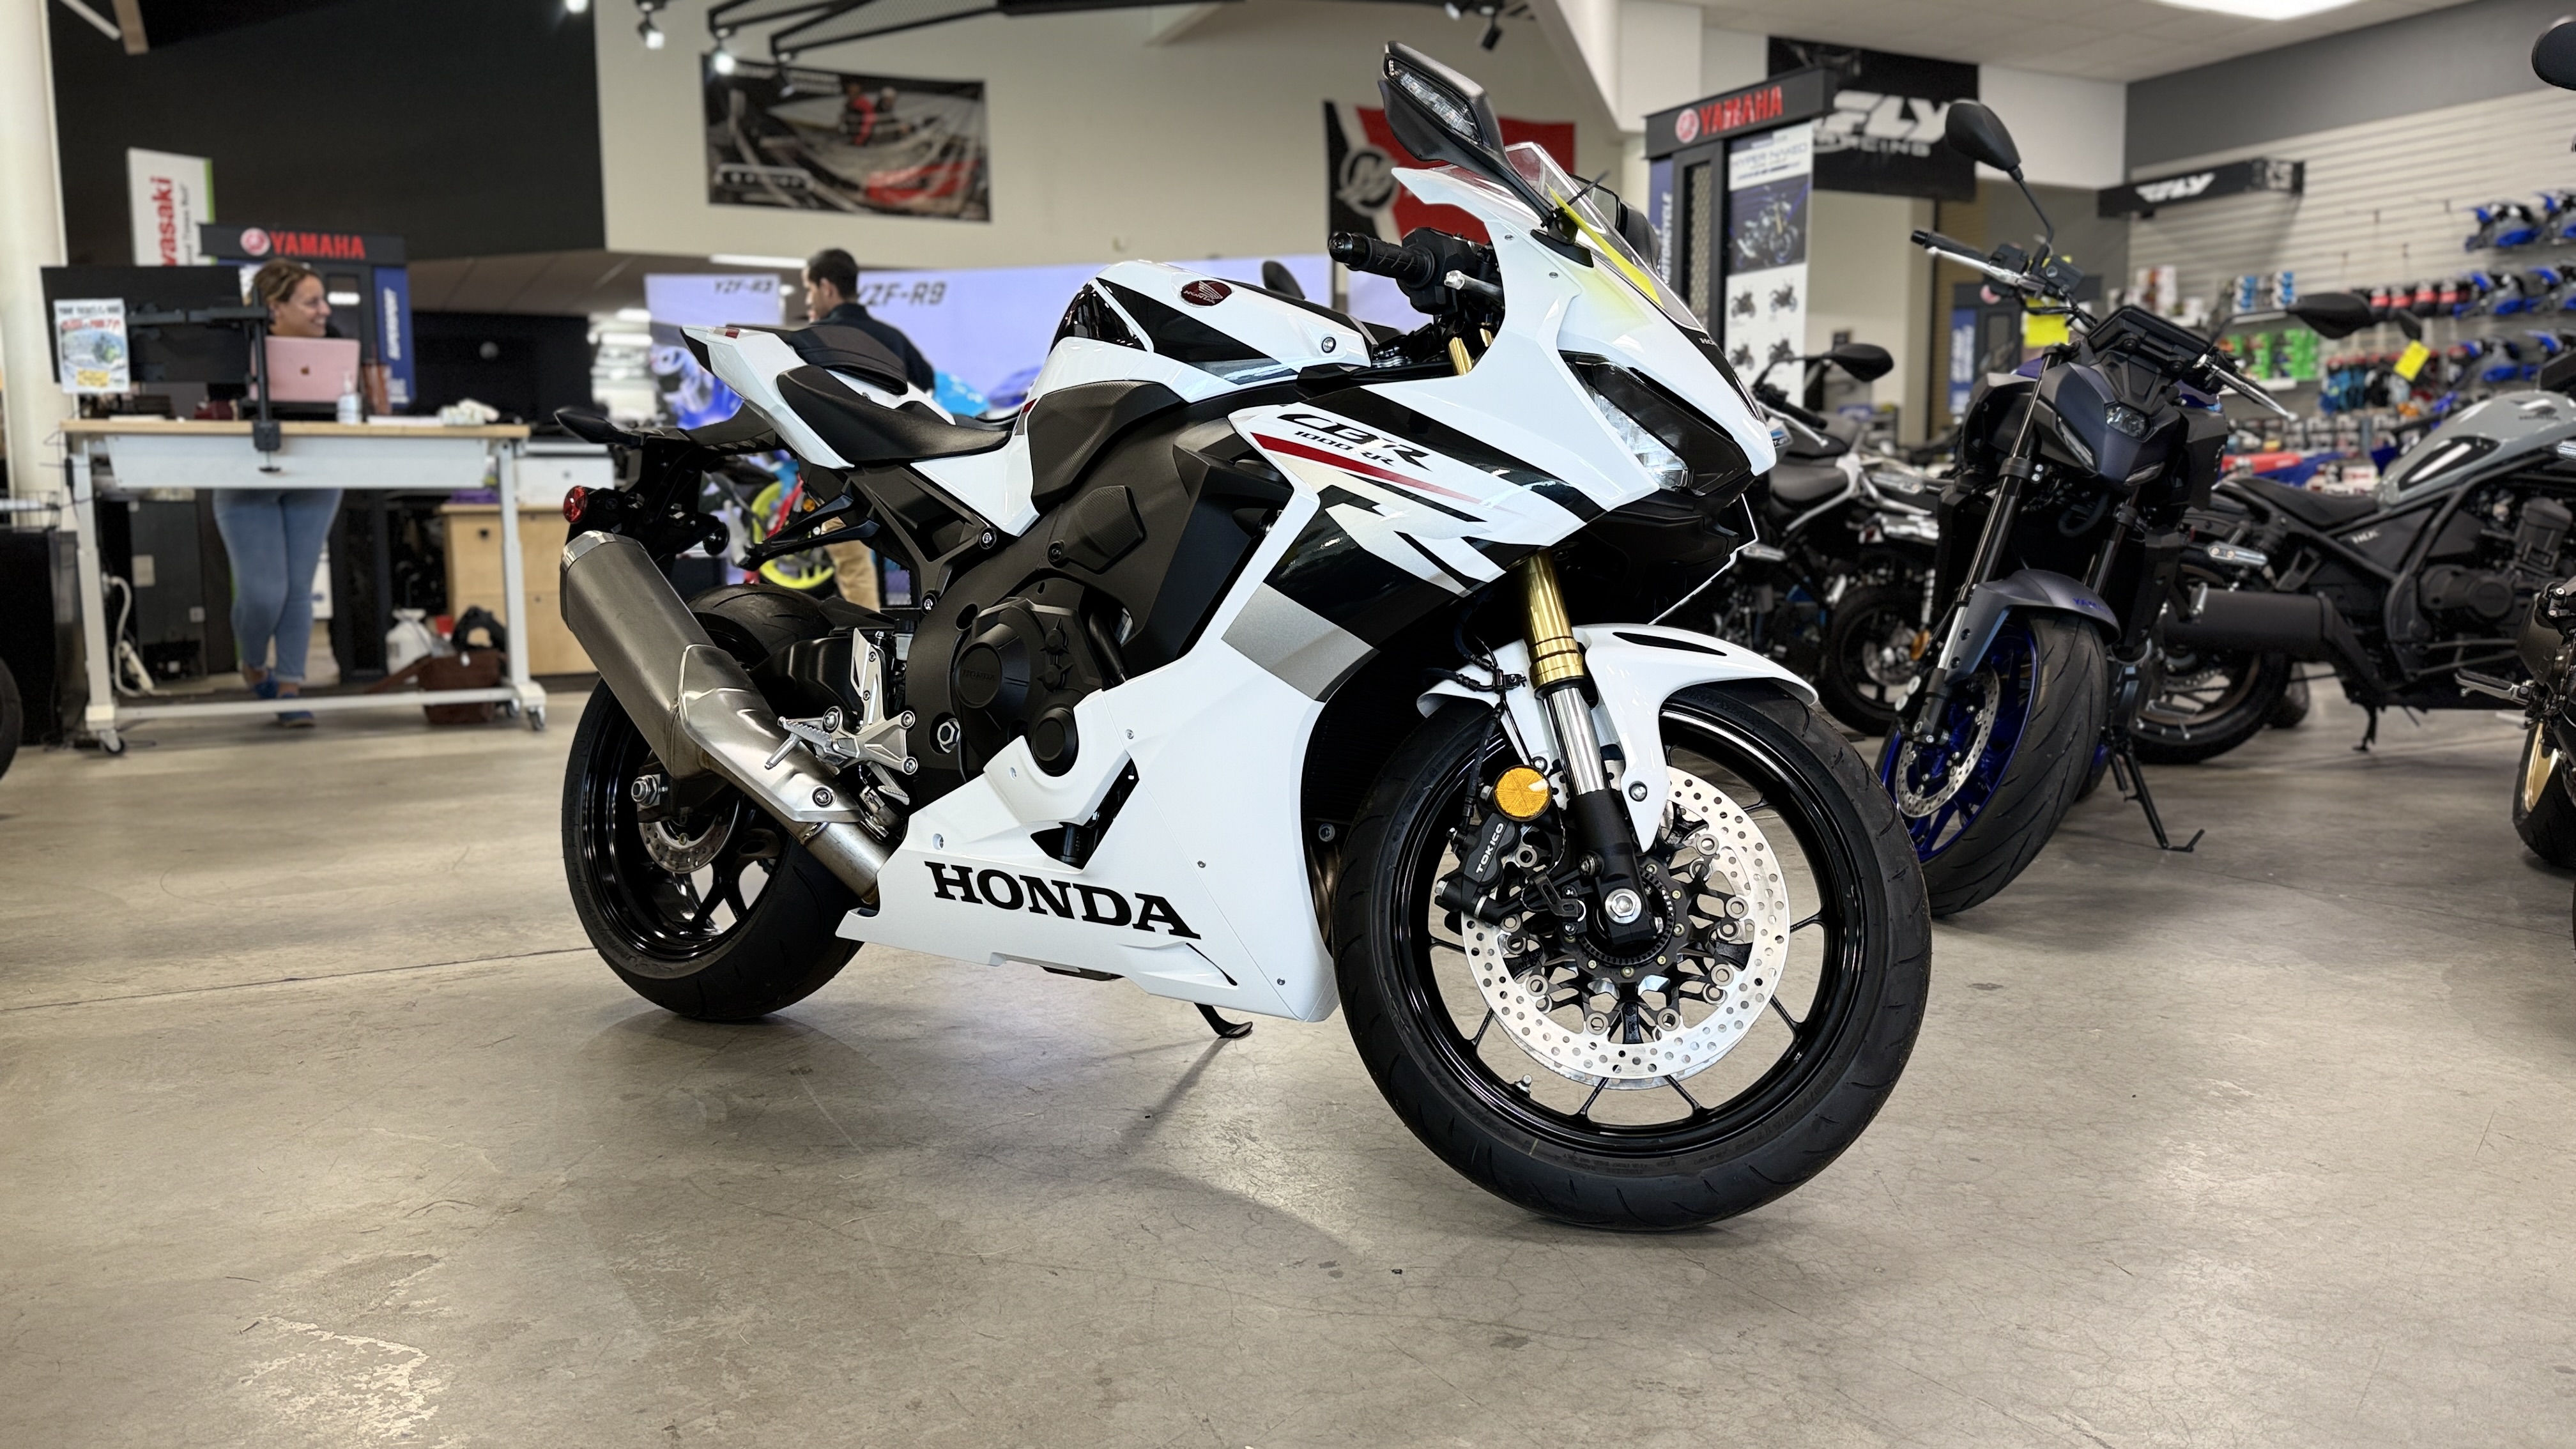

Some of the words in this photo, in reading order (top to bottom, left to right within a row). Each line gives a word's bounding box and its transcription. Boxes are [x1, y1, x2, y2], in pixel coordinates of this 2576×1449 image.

[1699, 85, 1784, 137] YAMAHA
[1816, 90, 1952, 144] FLY
[2135, 171, 2215, 203] FLY
[268, 231, 366, 259] YAMAHA
[1183, 289, 1216, 304] HONDA
[1276, 413, 1433, 472] CBR
[961, 668, 997, 682] HONDA
[1475, 822, 1505, 874] TOKICO
[924, 861, 1202, 940] HONDA
